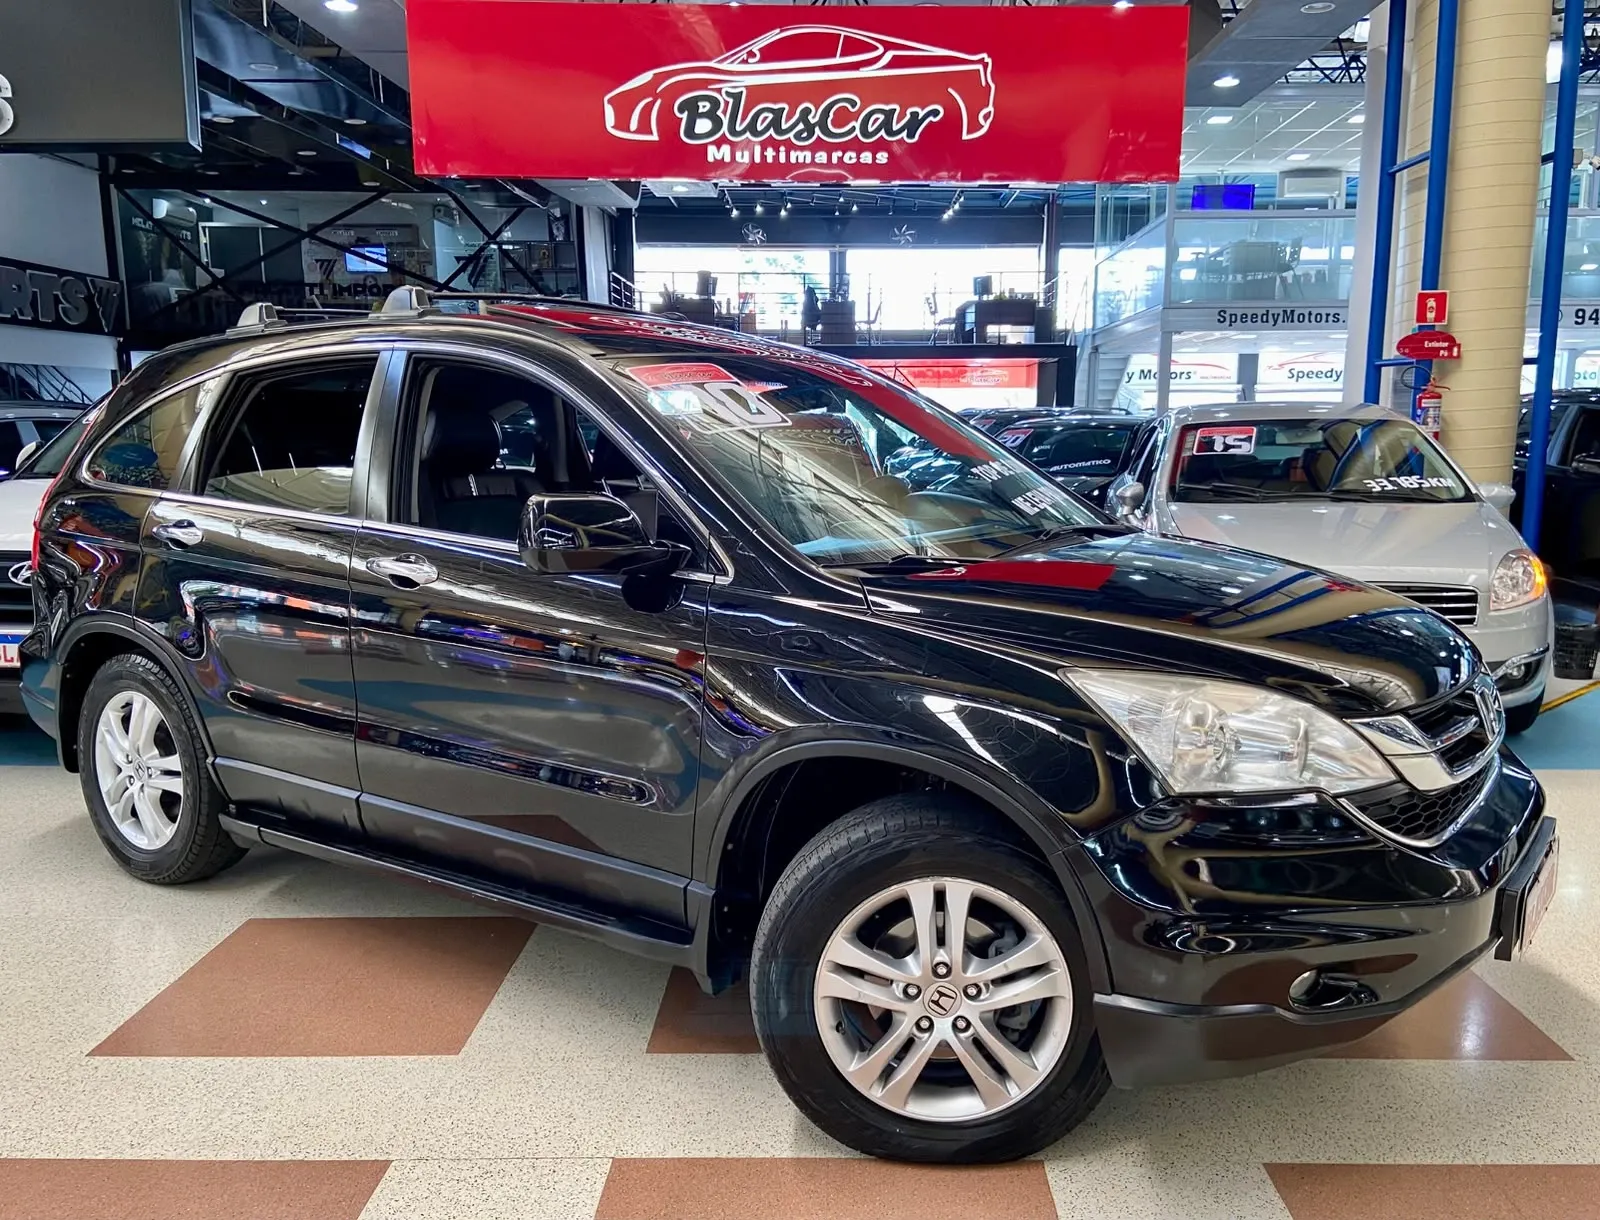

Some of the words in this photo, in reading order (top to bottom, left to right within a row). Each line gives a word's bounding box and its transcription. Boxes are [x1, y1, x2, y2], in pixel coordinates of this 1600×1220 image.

[674, 89, 943, 144] BlasCar
[707, 145, 889, 165] Multimarcas
[1217, 309, 1346, 327] SpeedyMotors.
[1138, 368, 1192, 380] Moors
[1287, 367, 1343, 383] Speedy
[1212, 434, 1251, 453] 15
